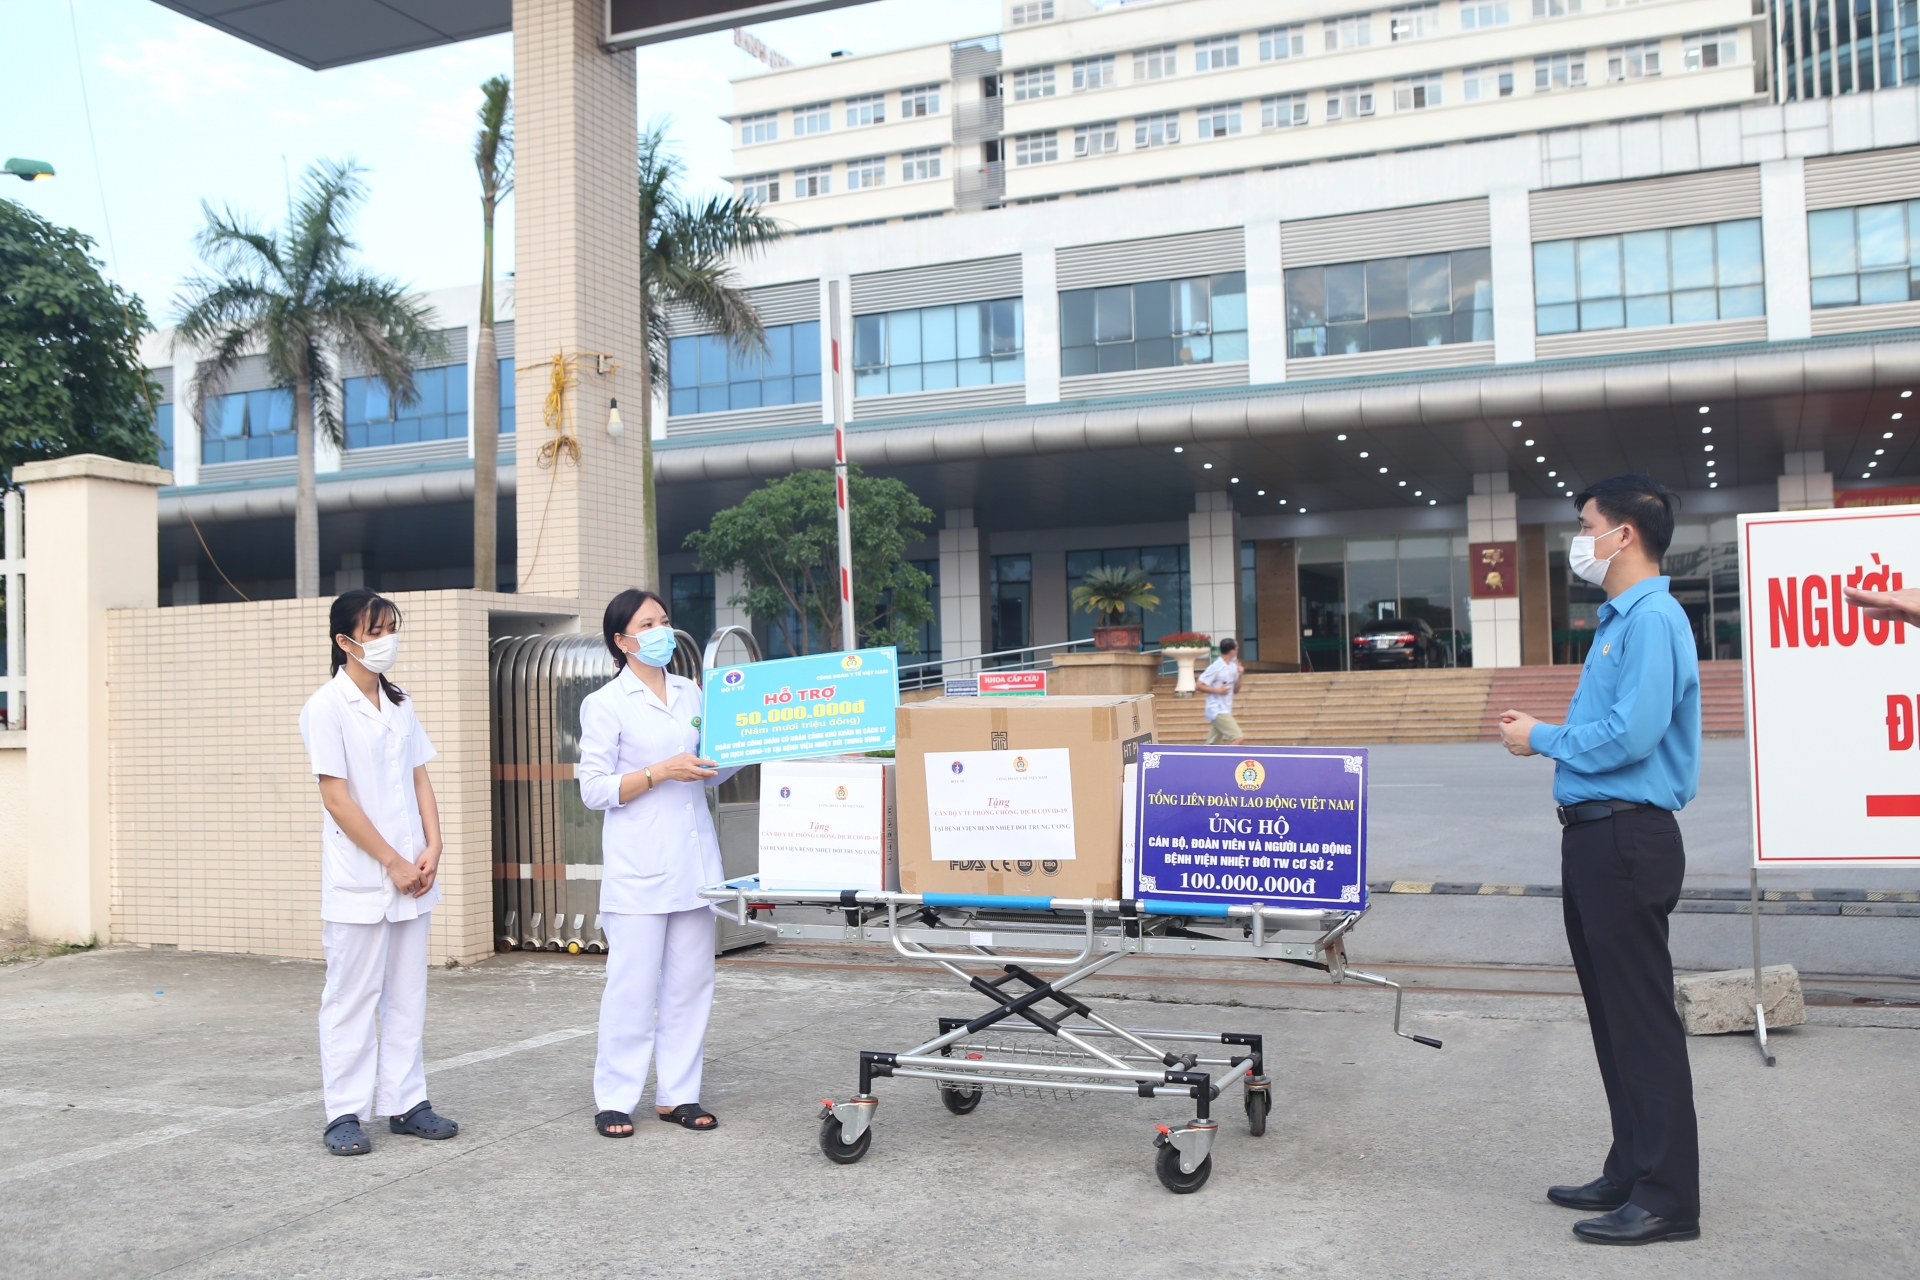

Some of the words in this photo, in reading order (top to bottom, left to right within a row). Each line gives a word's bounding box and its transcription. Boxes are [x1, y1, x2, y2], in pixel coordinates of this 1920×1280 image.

[1768, 552, 1906, 649] NGƯỜI
[1007, 674, 1022, 682] CẤP
[764, 686, 792, 706] HỖ
[796, 685, 836, 701] TRỢ
[736, 700, 865, 727] 50.000.000đ
[1886, 694, 1920, 751] Đ
[741, 727, 768, 737] (Năm
[772, 723, 798, 732] mươi
[802, 720, 826, 728] triệu
[829, 716, 860, 725] đồng)
[745, 747, 771, 756] COVID-19
[1124, 743, 1132, 758] HT
[988, 798, 1010, 808] Tặng
[1148, 789, 1178, 805] TỔNG
[1180, 792, 1205, 806] LIÊN
[1208, 793, 1238, 807] ĐOÀN
[1240, 796, 1263, 808] LAO
[1266, 794, 1297, 811] ĐỘNG
[1300, 796, 1326, 812] VIỆT
[1328, 799, 1354, 810] NAM
[810, 822, 830, 832] Tặng
[1208, 813, 1253, 834] ỦNG
[1258, 815, 1290, 839] HỘ
[1148, 836, 1169, 848] CÁN
[1172, 836, 1189, 850] BỘ,
[1191, 837, 1219, 849] ĐOÀN
[1222, 838, 1245, 851] VIÊN
[1248, 839, 1262, 851] VÀ
[1265, 840, 1297, 852] NGƯỜI
[1300, 843, 1319, 853] LAO
[1322, 842, 1352, 856] ĐỘNG
[950, 860, 986, 871] FDA
[1164, 852, 1192, 866] BỆNH
[1194, 854, 1217, 867] VIỆN
[1220, 855, 1250, 869] NHIỆT
[1253, 856, 1270, 868] ĐỚI
[1273, 858, 1289, 868] TW
[1292, 858, 1307, 869] CƠ
[1310, 857, 1325, 870] SỞ
[1327, 860, 1334, 870] 2
[1180, 872, 1316, 894] 100.000.000đ
